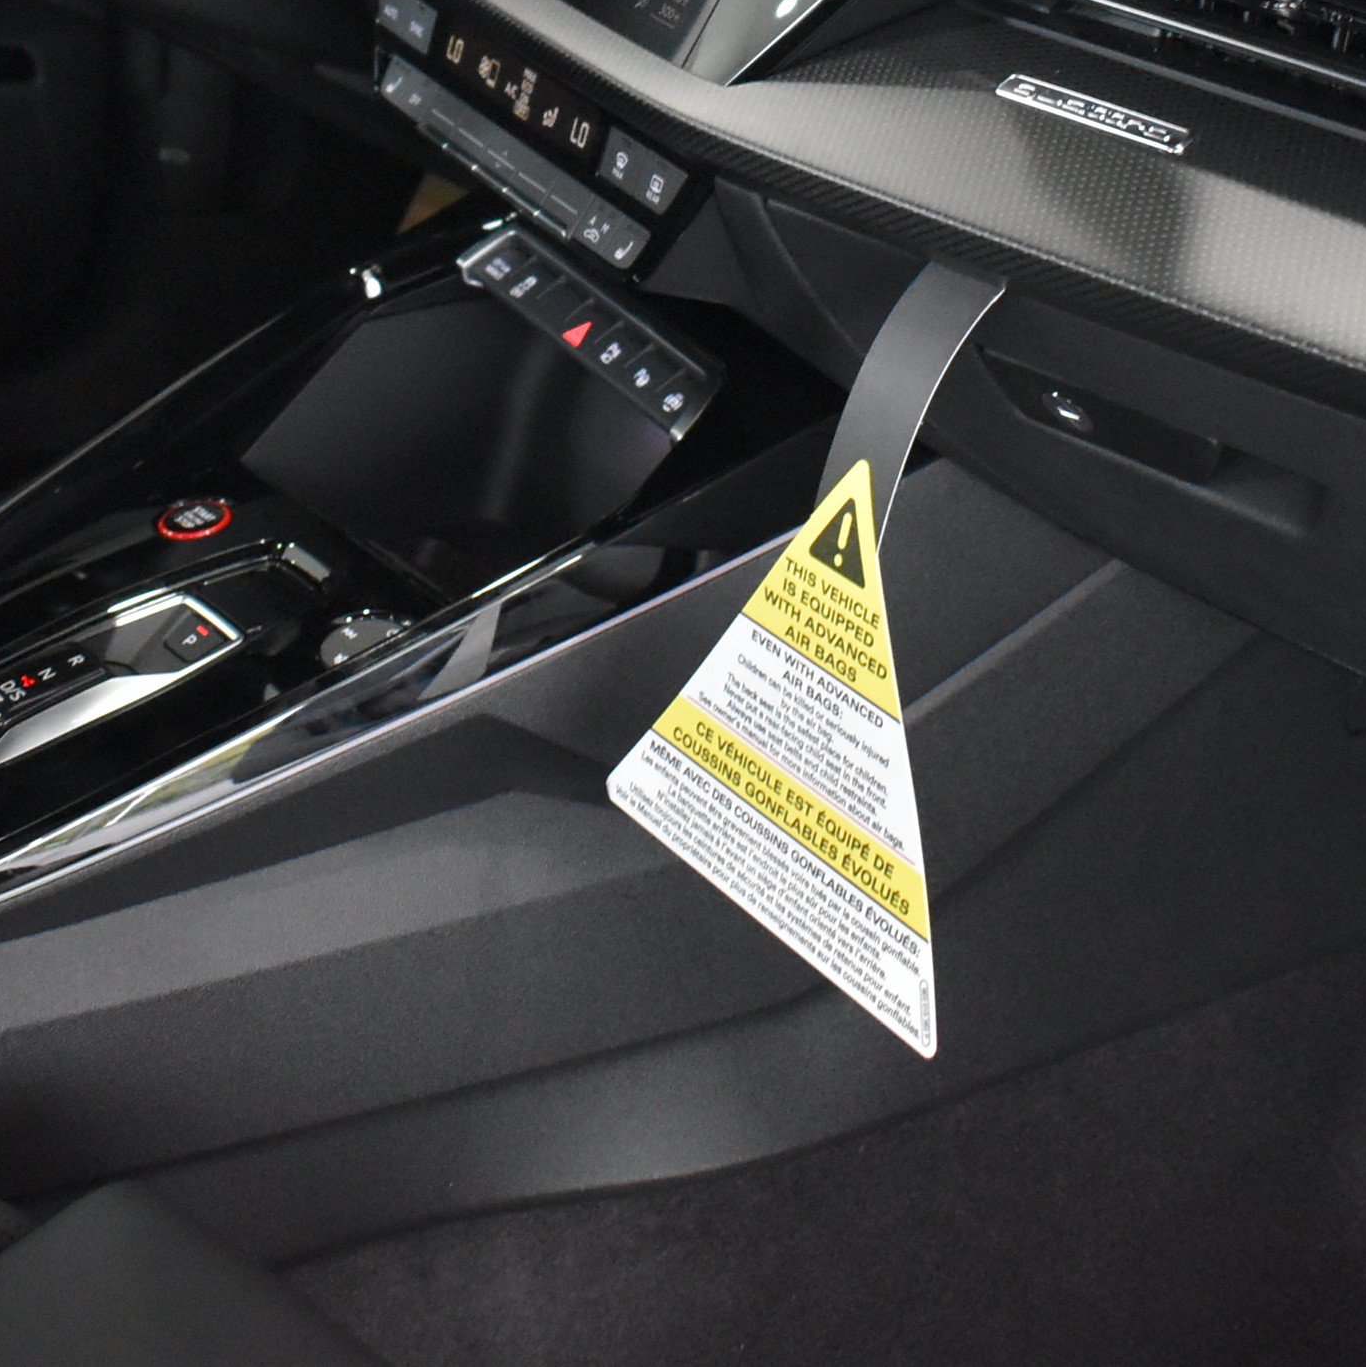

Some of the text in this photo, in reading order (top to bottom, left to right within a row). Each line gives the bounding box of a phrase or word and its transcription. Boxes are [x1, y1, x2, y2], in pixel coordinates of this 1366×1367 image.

[782, 577, 875, 650] IS EQUIPPED
[783, 555, 880, 630] THIS VEHICLE
[68, 653, 85, 668] R
[181, 633, 198, 646] P
[762, 586, 888, 682] WITH ADVANCED
[784, 623, 857, 684] AIR BAGS
[0, 678, 28, 702] D/S
[38, 666, 57, 682] N
[751, 628, 884, 730] EVEN WITH ADVANCED
[782, 668, 843, 720] AIR BAGS:
[672, 724, 910, 917] COUSSINS GONFLABLES ÉVOLUÉS
[695, 719, 894, 880] CE VÉHICULE EST ÉQUIPÉ DE
[649, 737, 921, 958] MÊME AVEC DES COUSSINS GONFLABLES ÉVOLUÉS:
